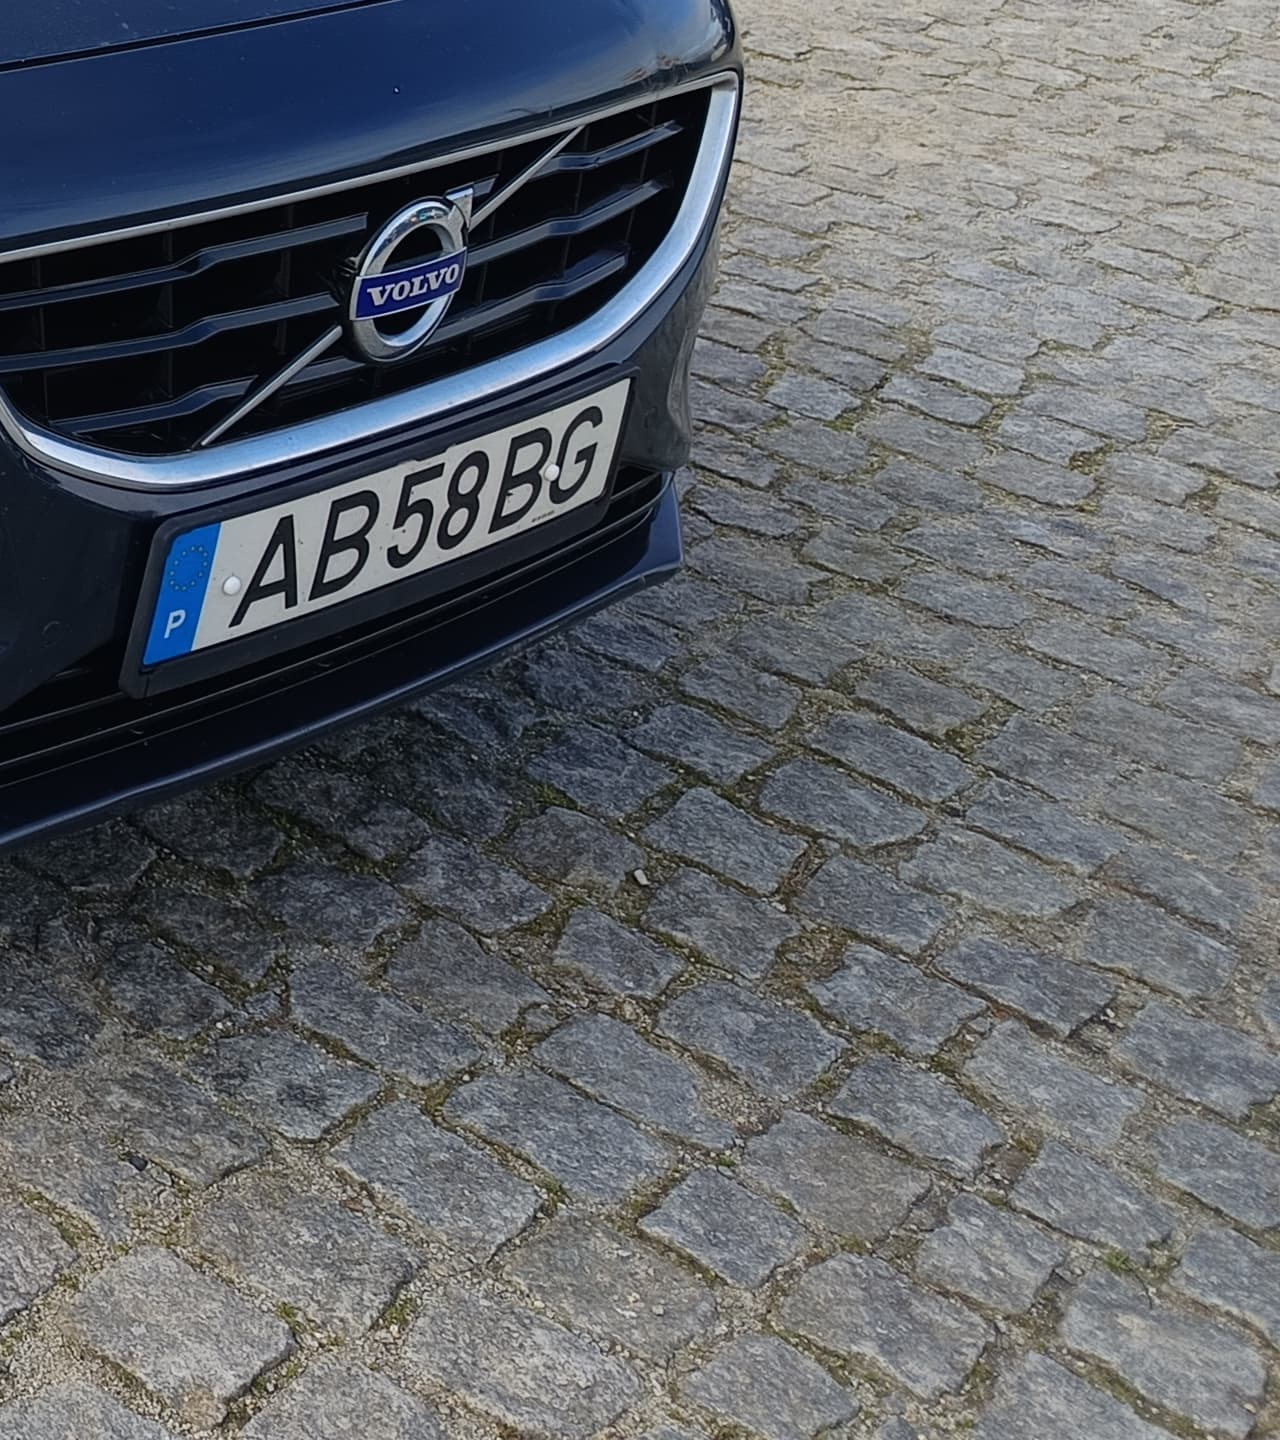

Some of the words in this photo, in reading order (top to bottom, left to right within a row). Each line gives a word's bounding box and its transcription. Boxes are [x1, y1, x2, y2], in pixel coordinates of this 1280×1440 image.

[366, 262, 460, 307] VOLVO
[228, 405, 604, 629] AB58BG
[164, 609, 188, 639] P
